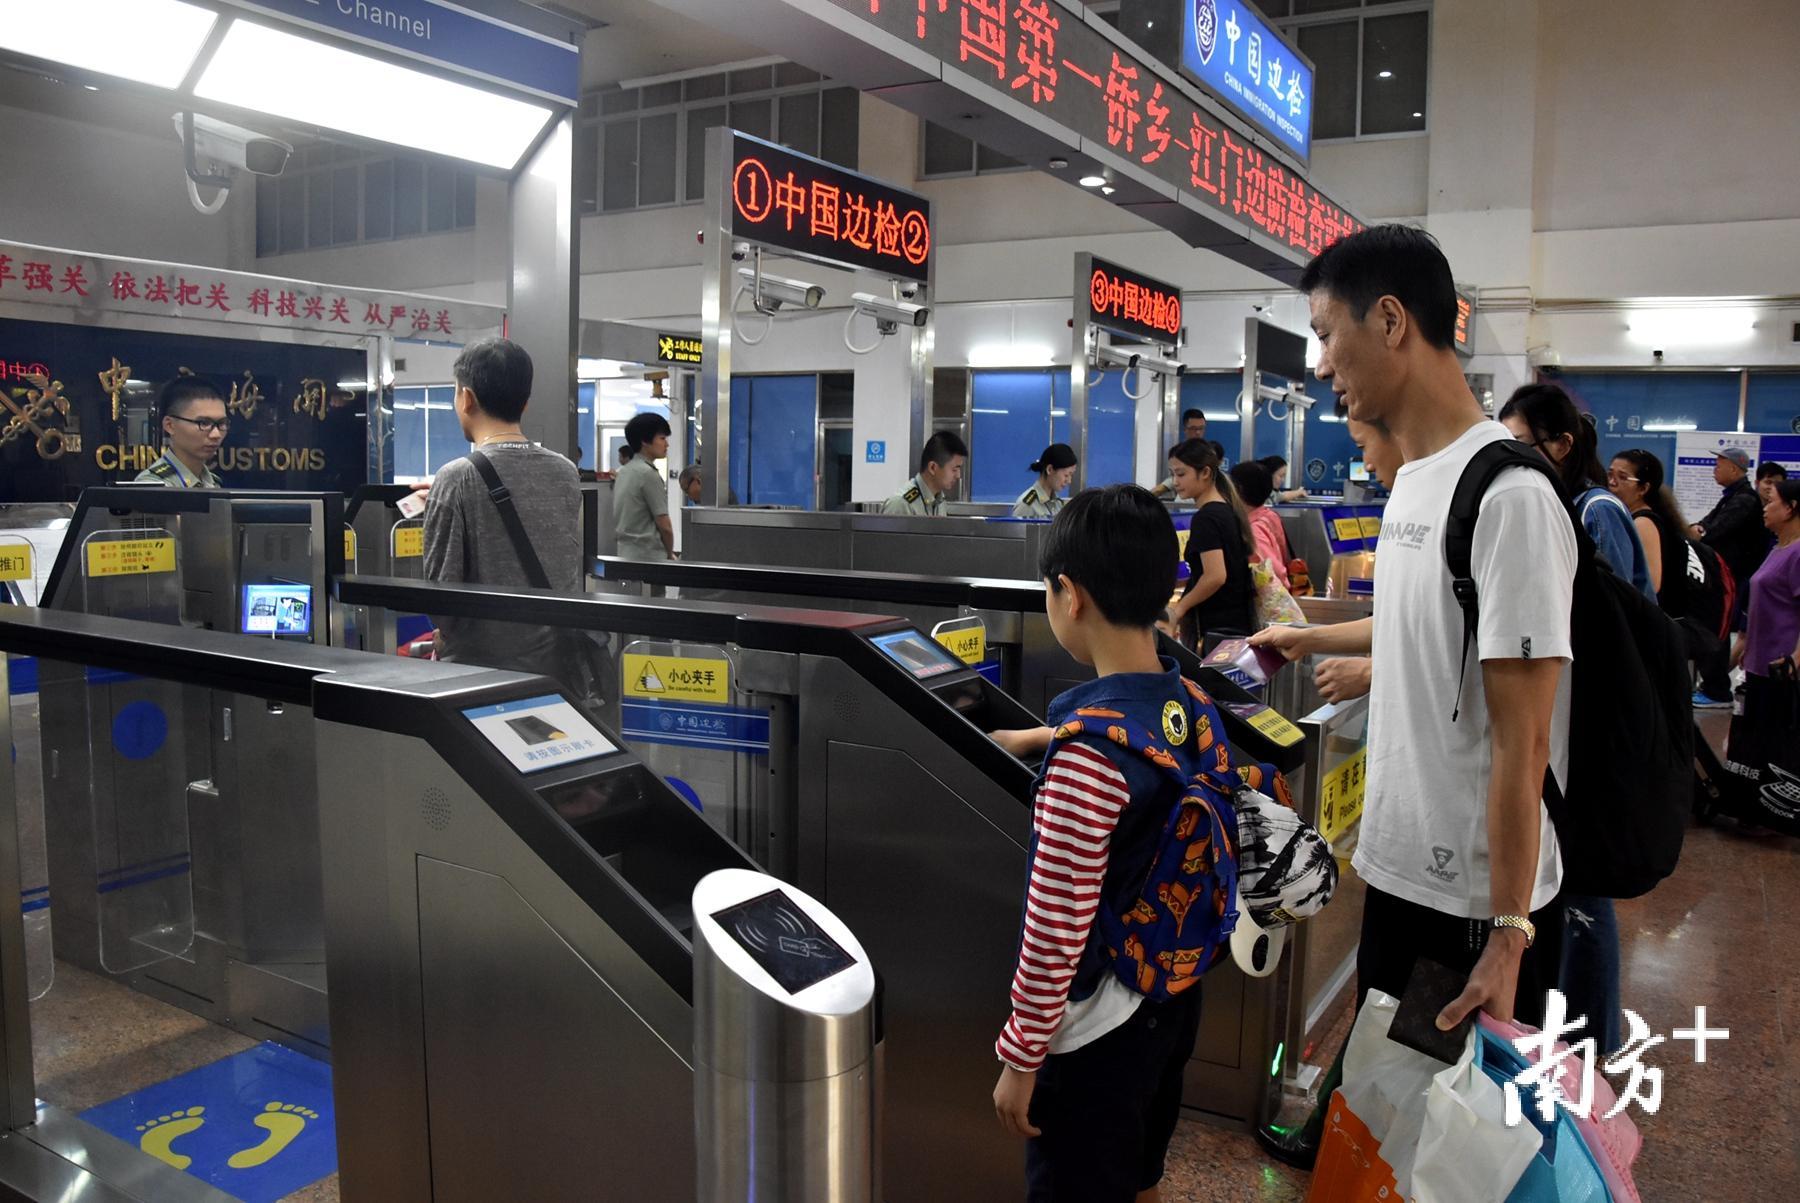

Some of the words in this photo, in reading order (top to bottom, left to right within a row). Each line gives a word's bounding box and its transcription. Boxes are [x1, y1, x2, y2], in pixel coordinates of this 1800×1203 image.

[337, 0, 431, 39] Channel
[1225, 9, 1305, 117] 中国边检
[1224, 71, 1243, 96] CHINA
[1276, 114, 1304, 144] INSPECTION
[111, 271, 231, 312] 依法把关
[248, 288, 350, 324] 科技兴关
[362, 303, 453, 335] 从严治关
[96, 444, 170, 471] CHIN
[668, 668, 716, 686] 小心夹手
[523, 739, 595, 762] 请按图示刷卡
